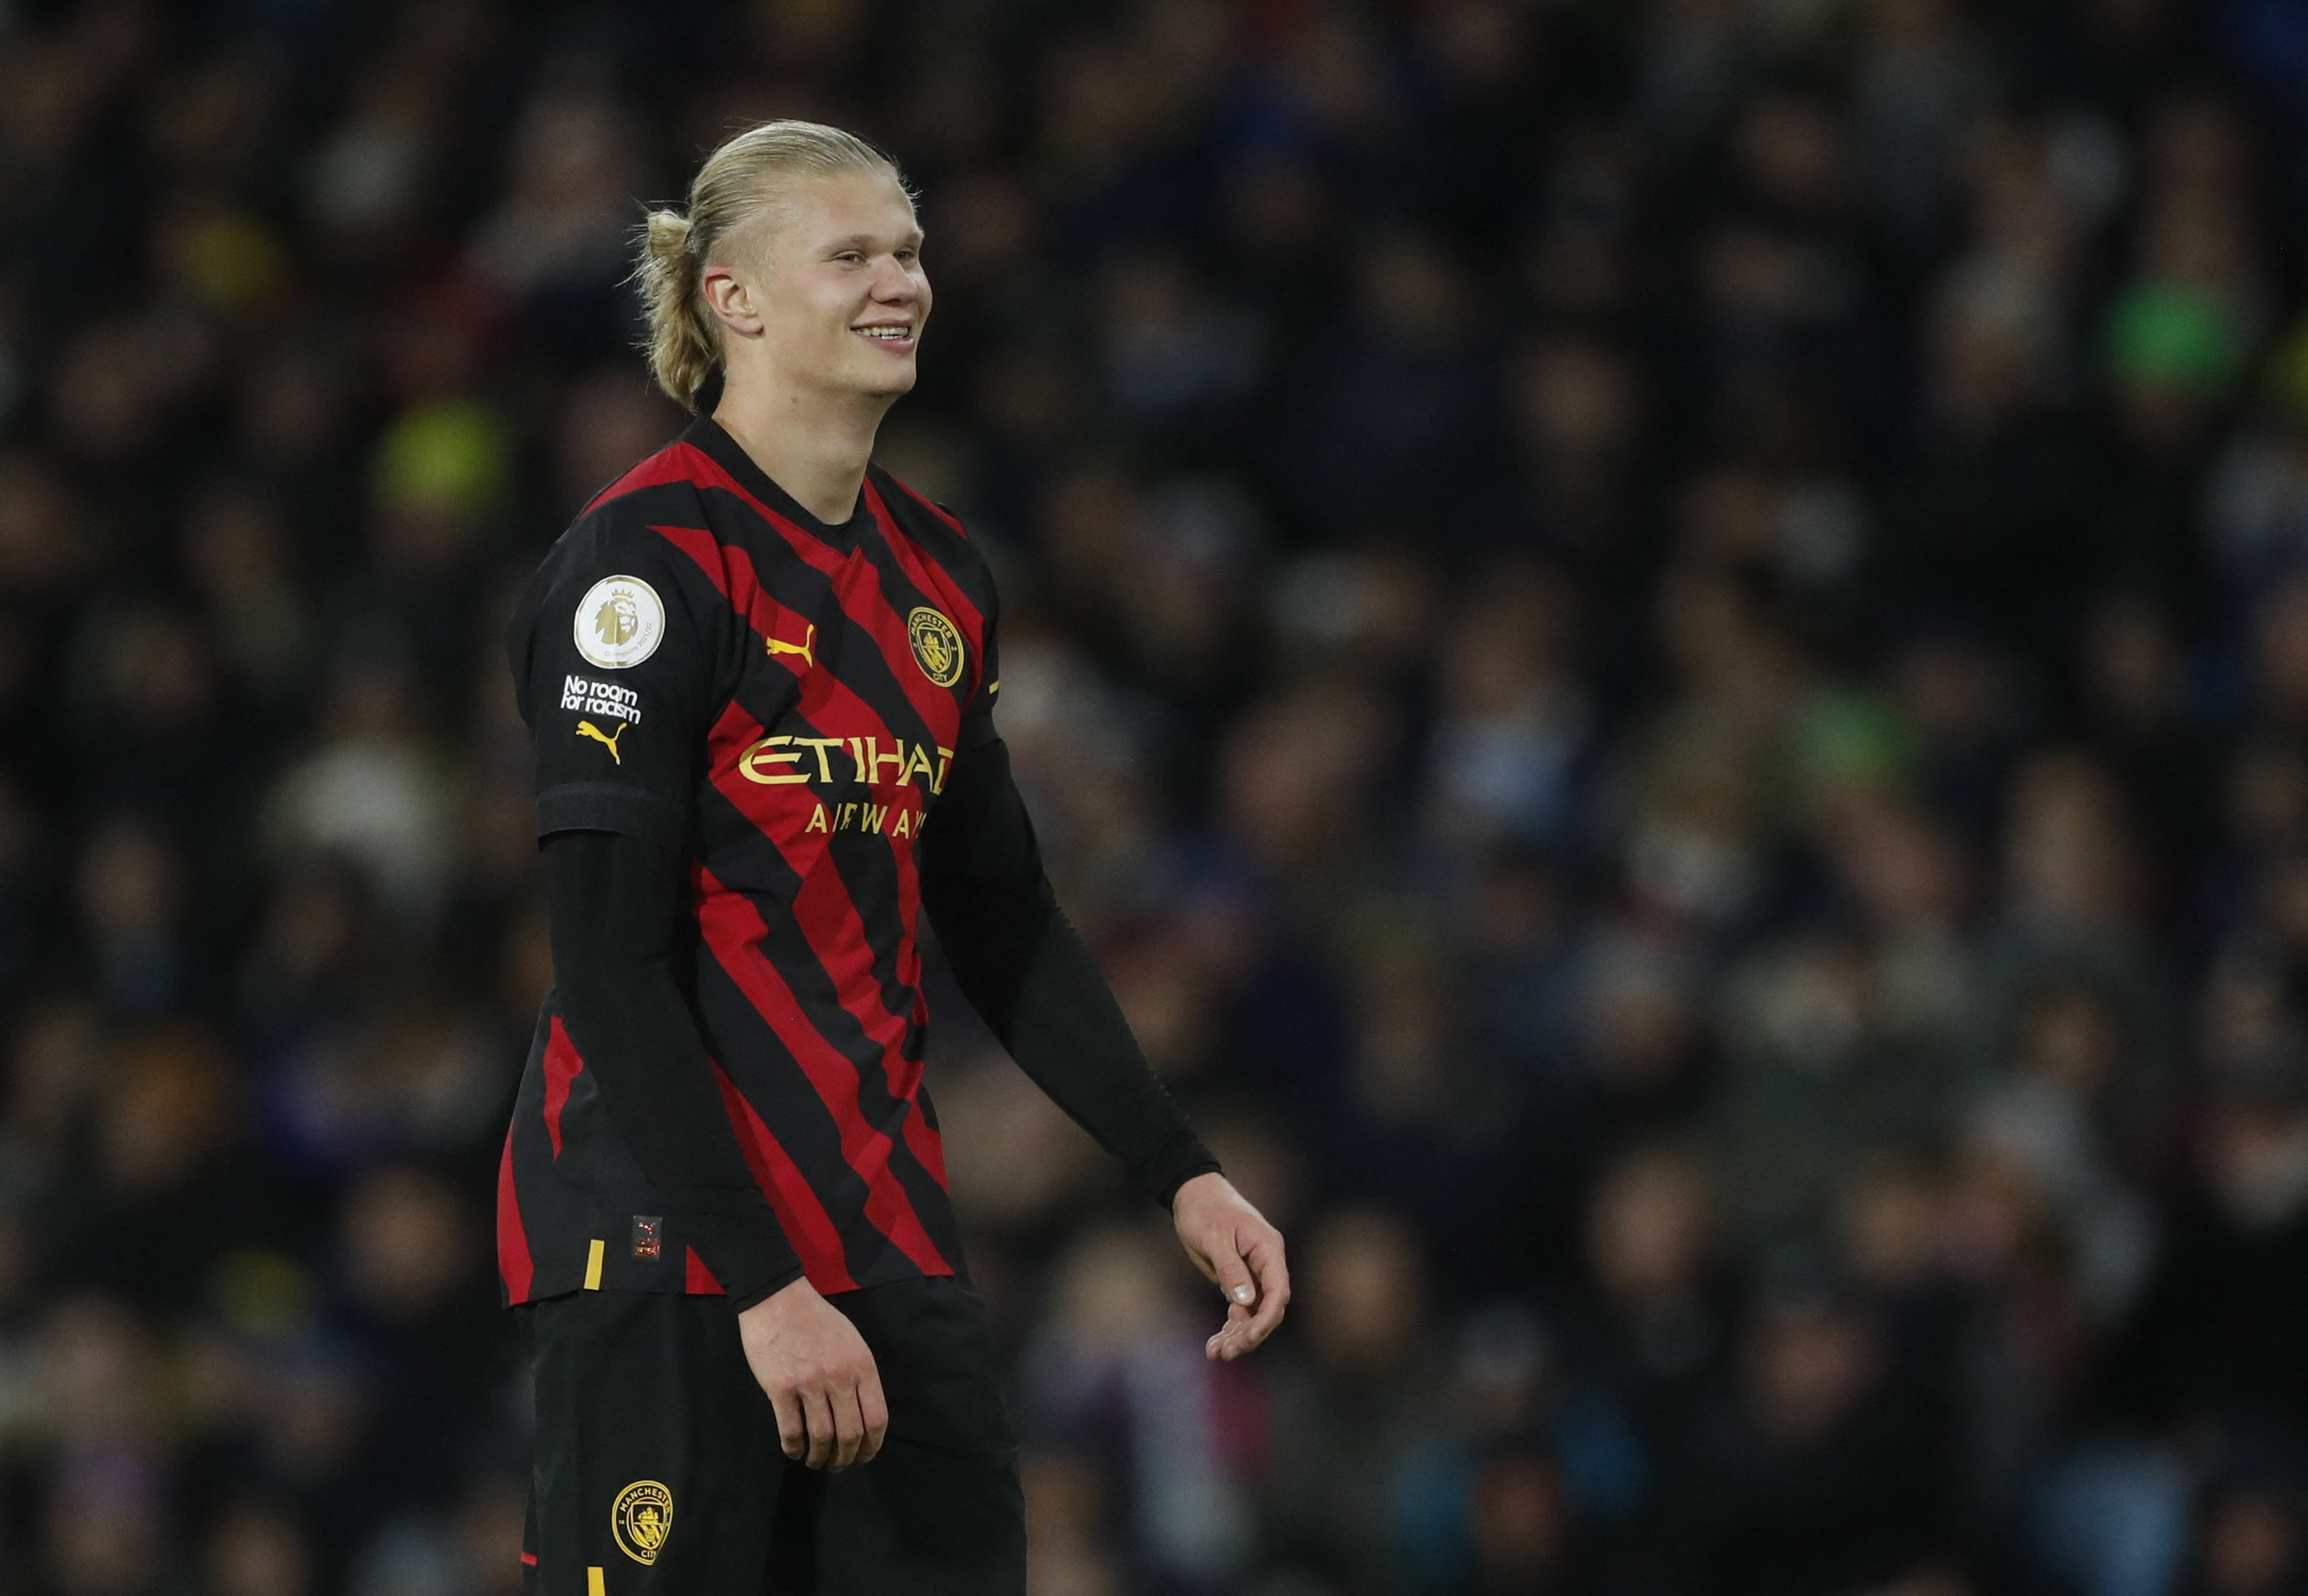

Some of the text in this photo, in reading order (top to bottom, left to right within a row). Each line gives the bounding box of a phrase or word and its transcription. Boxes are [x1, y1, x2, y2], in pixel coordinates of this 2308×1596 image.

[564, 675, 638, 707] No room
[561, 691, 641, 724] for racism
